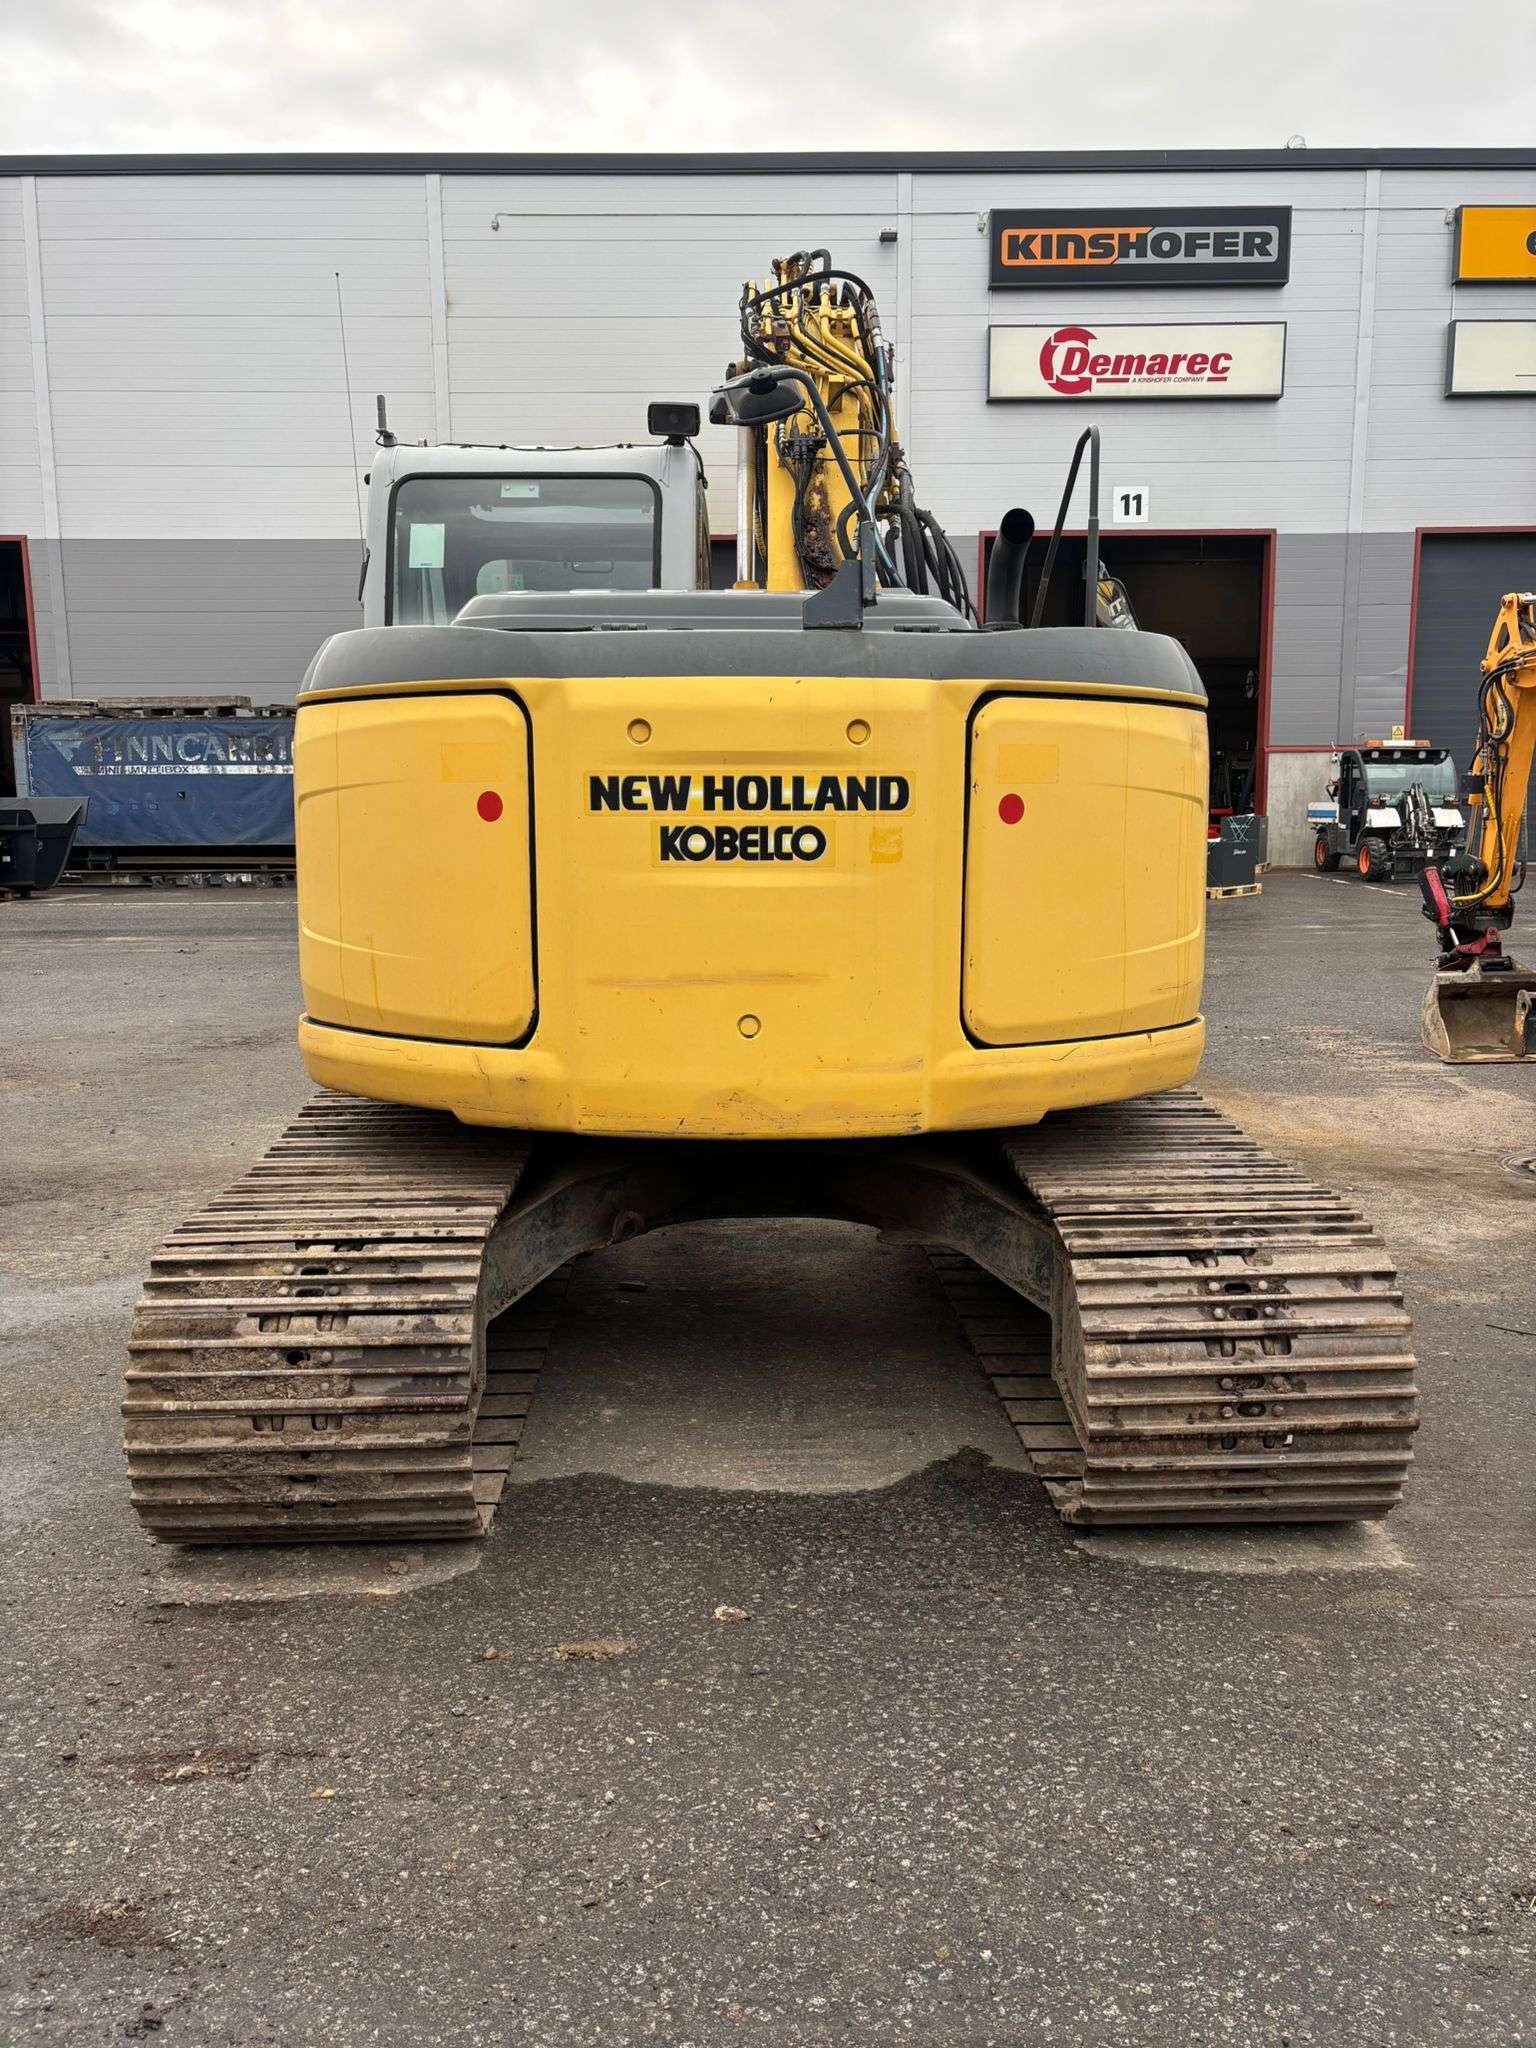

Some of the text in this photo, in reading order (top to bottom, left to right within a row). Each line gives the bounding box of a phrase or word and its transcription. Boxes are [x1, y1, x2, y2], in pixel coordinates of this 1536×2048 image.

[1060, 346, 1233, 376] Demarec
[1120, 493, 1142, 516] 11
[129, 765, 189, 775] MULTIBOX
[589, 775, 910, 811] NEW HOLLAND
[659, 825, 827, 861] KOBELCO
